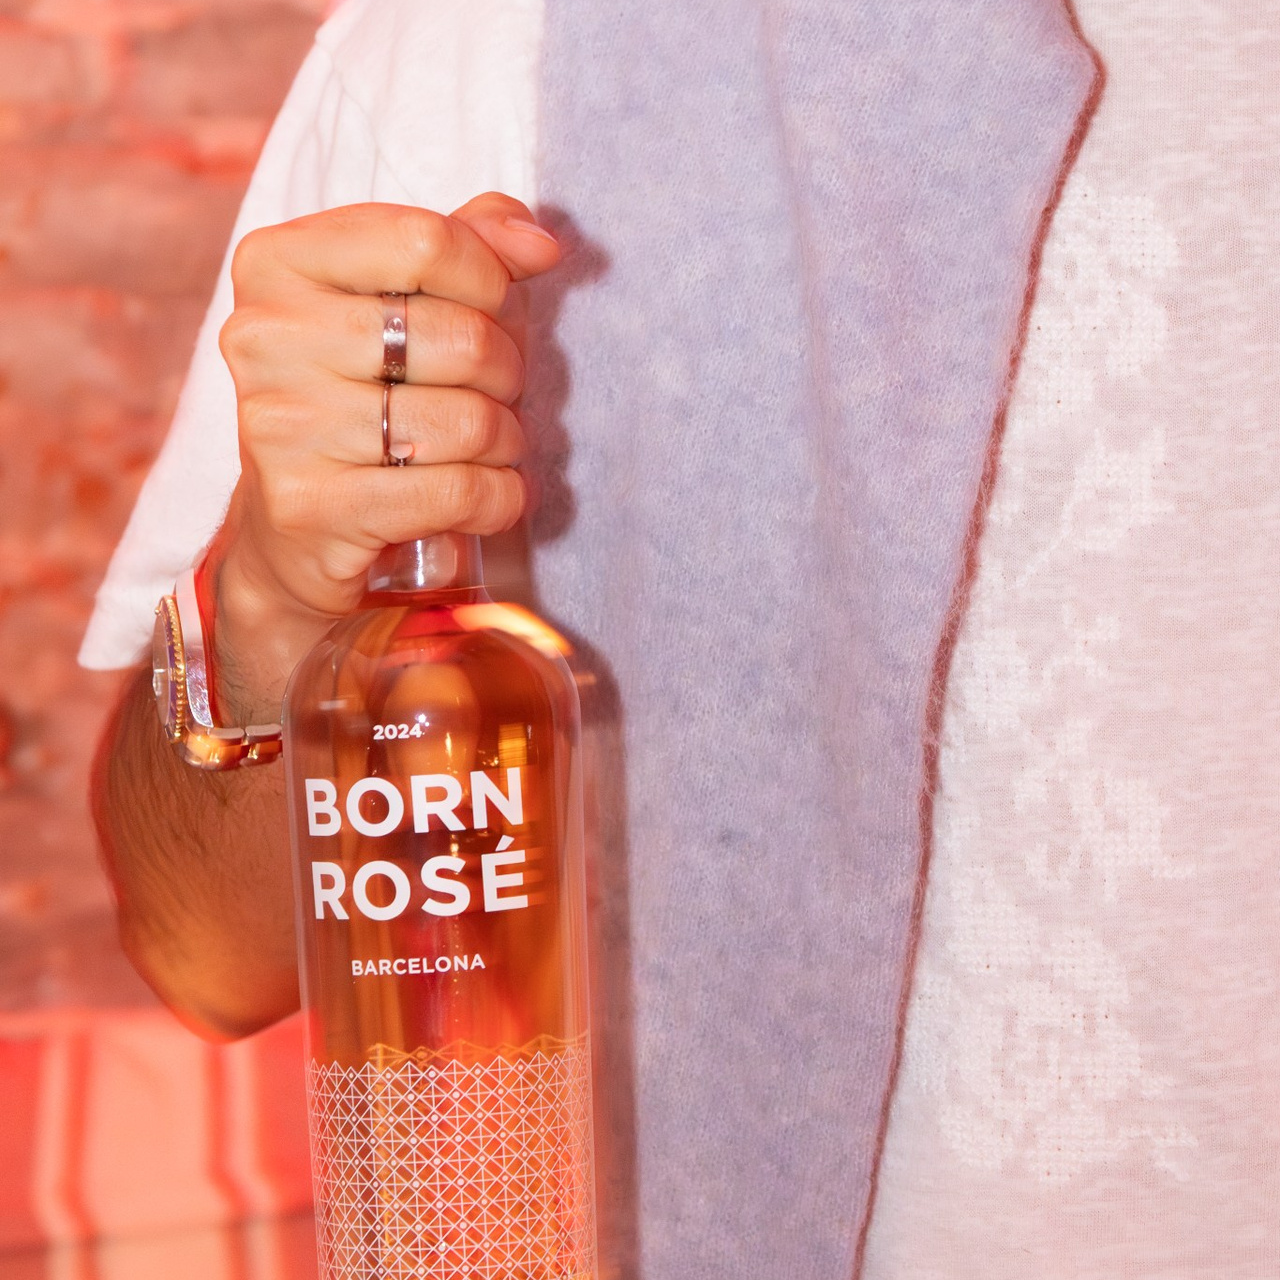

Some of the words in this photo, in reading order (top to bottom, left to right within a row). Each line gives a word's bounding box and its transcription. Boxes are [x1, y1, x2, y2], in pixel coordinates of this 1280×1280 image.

[372, 724, 422, 740] 2024
[305, 767, 524, 837] BORN
[311, 835, 529, 921] ROSÉ
[351, 953, 487, 977] BARCELONA
